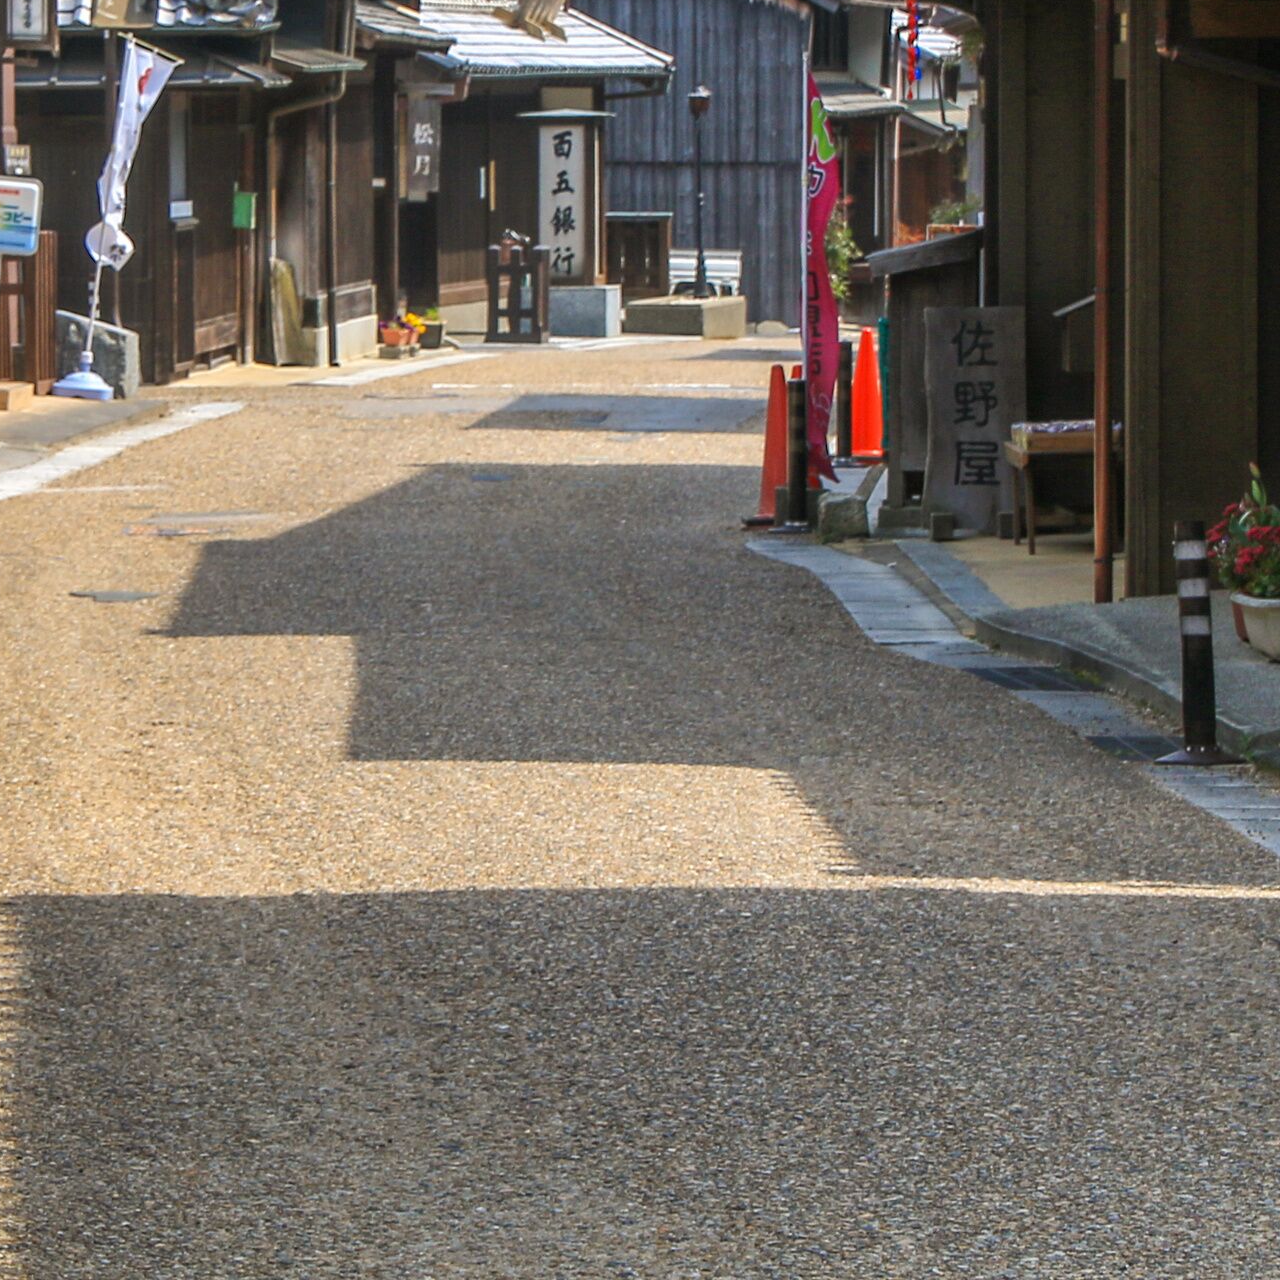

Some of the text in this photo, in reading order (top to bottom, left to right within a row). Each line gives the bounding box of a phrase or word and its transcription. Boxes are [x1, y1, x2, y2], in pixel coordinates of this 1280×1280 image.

[551, 130, 576, 276] 百五銀行
[951, 320, 1001, 486] 佐野屋
